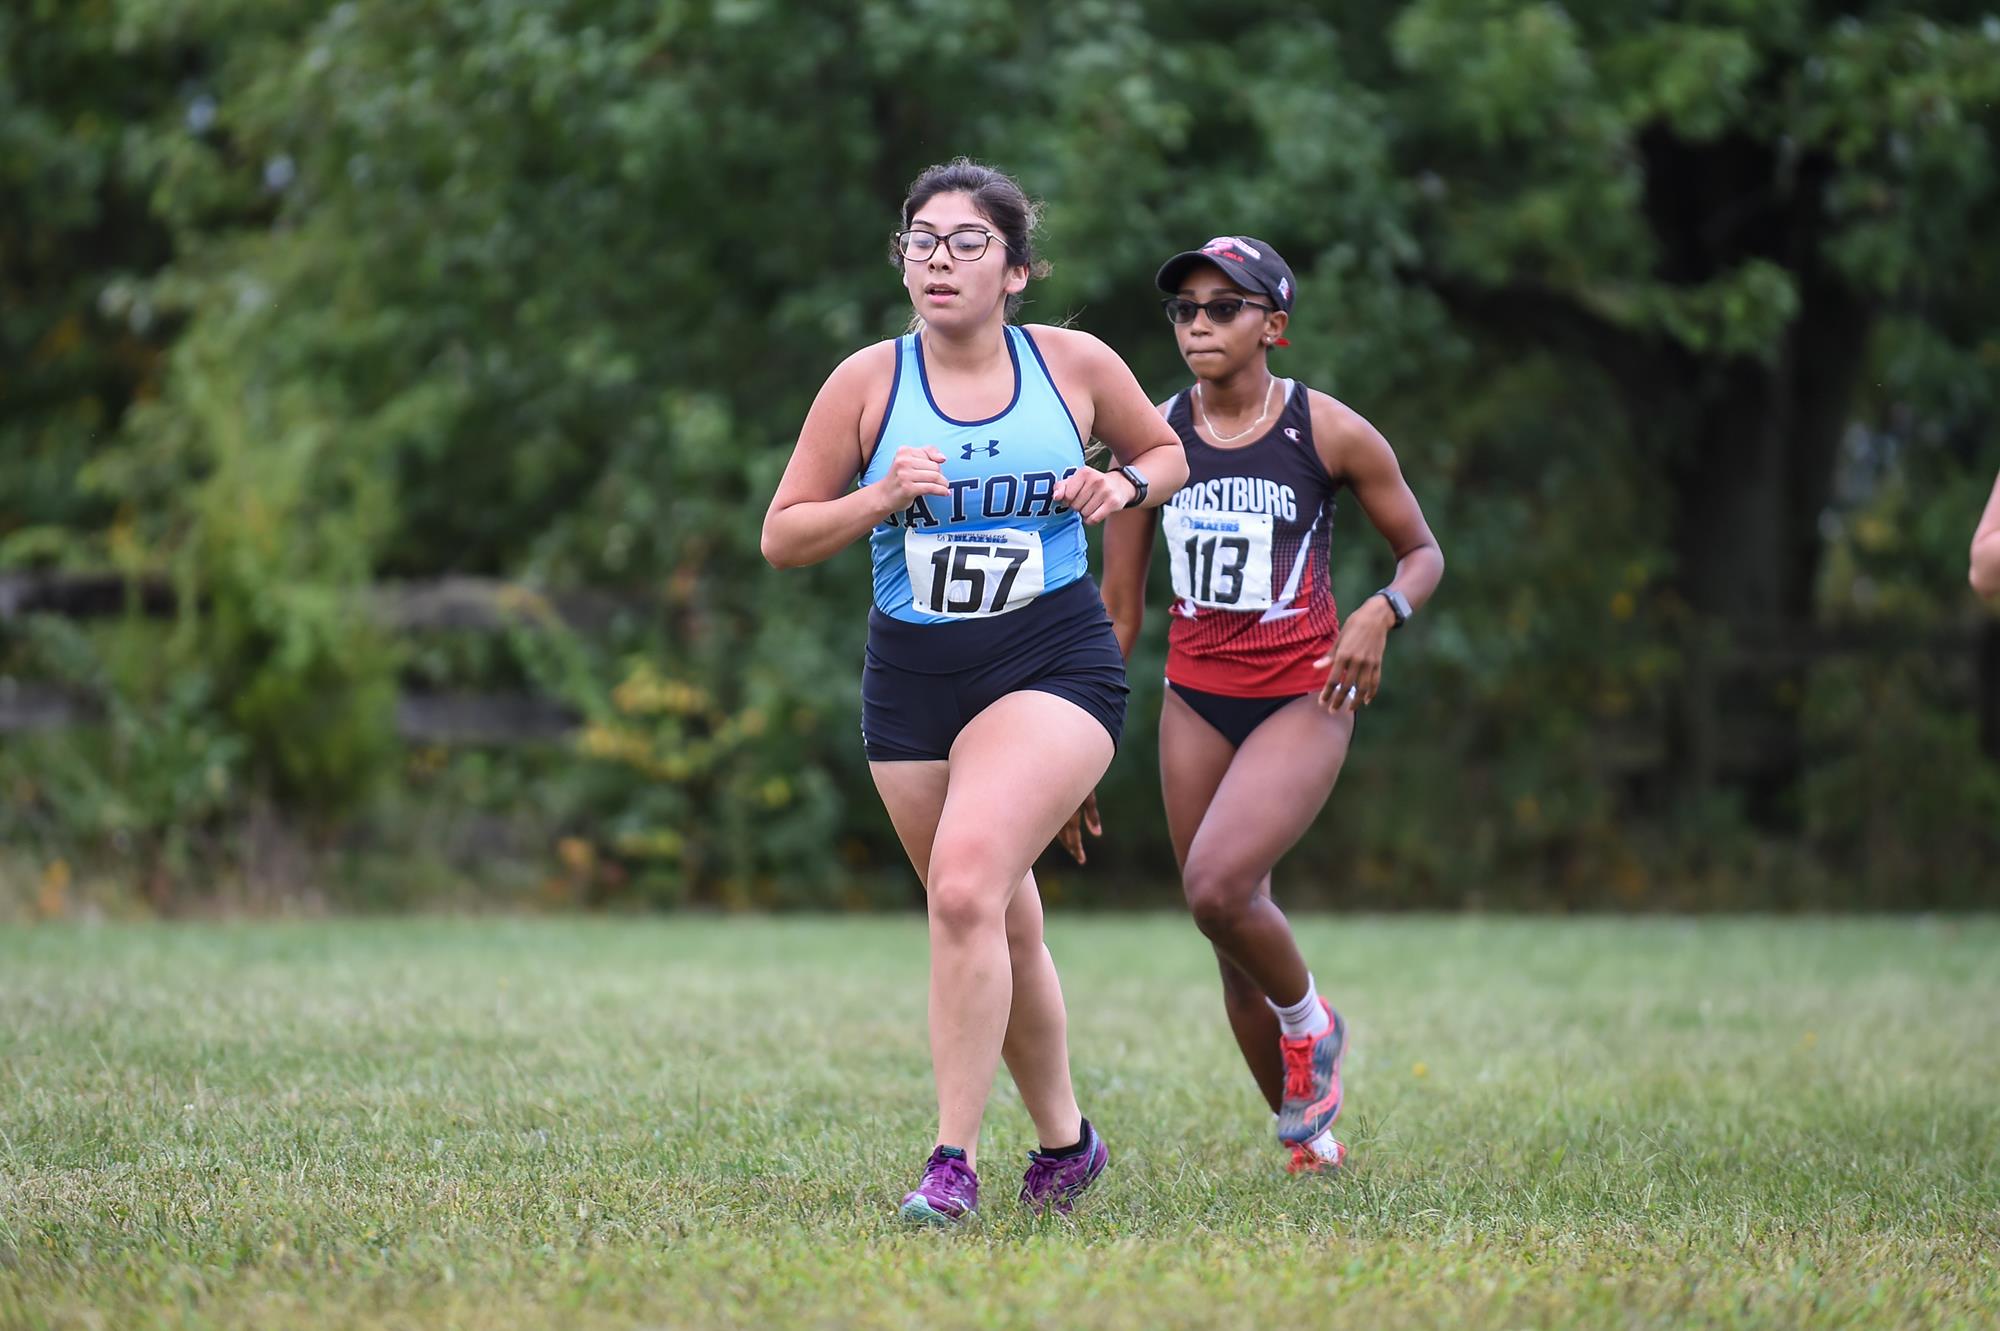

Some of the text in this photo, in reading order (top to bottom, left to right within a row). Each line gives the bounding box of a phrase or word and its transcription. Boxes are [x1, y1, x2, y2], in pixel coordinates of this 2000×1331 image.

[883, 467, 1077, 528] ATOR
[930, 545, 1030, 613] 157
[1185, 535, 1250, 604] 113
